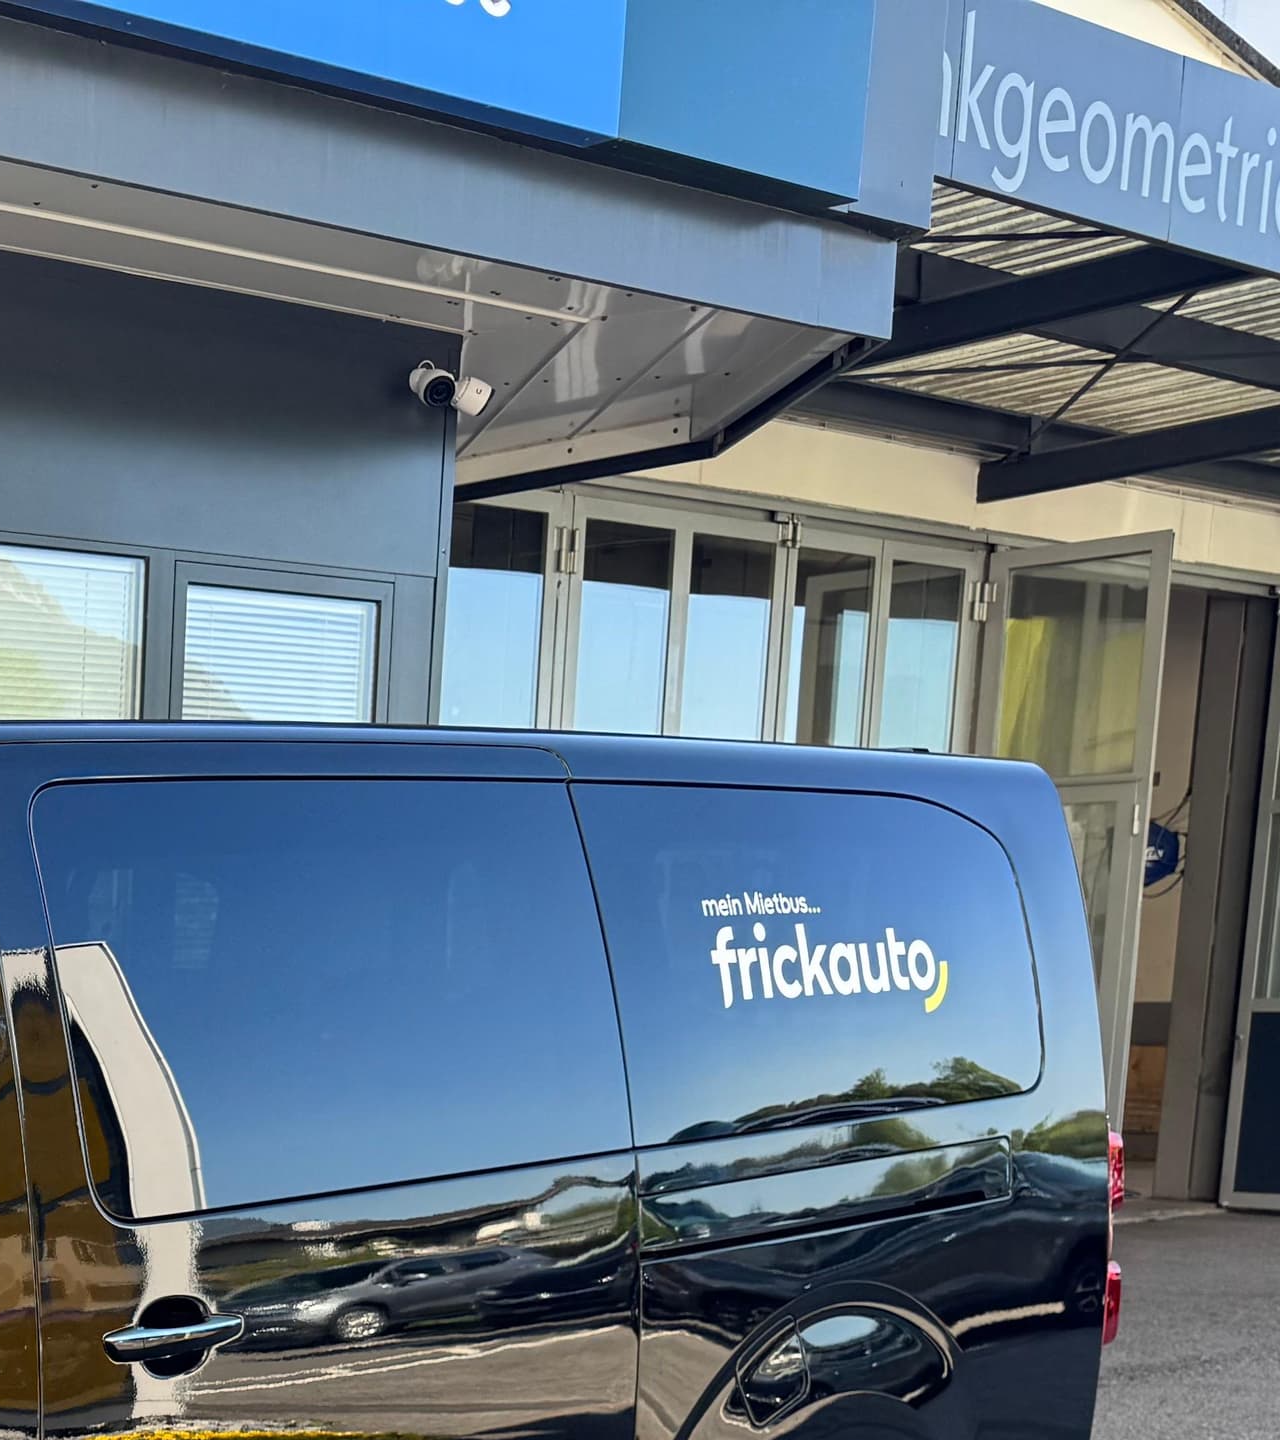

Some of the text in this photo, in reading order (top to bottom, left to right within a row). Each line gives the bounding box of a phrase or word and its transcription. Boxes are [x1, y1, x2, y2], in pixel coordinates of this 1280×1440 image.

[939, 9, 1280, 234] kgeometri
[701, 891, 821, 917] mein Mietbus...
